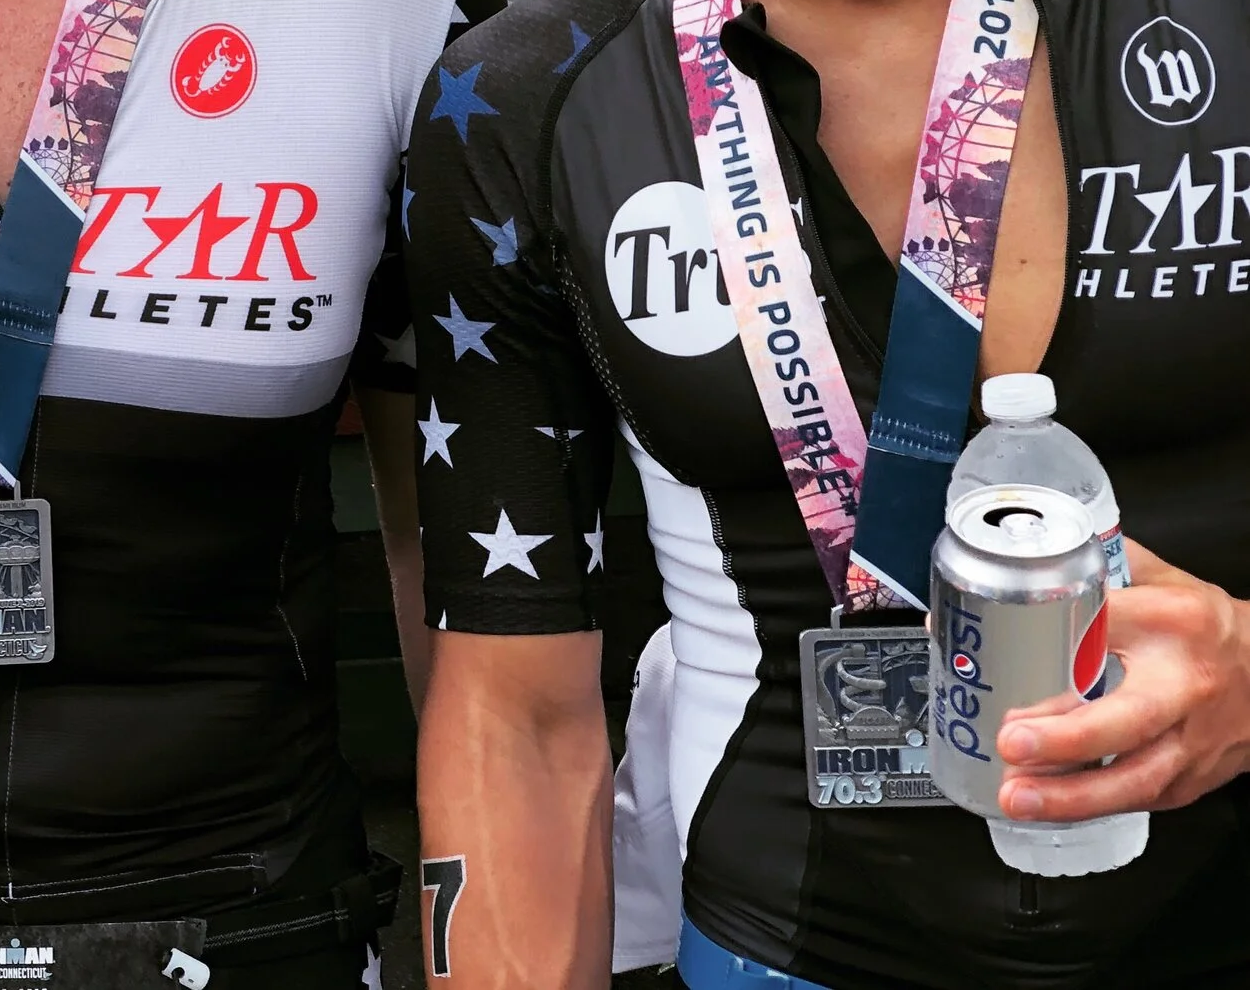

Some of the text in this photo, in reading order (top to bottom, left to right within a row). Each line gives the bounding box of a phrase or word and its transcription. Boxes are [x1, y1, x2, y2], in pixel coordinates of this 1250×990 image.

[697, 35, 768, 238] ANYTHING
[744, 250, 781, 289] IS
[1079, 146, 1250, 255] TAR
[1074, 259, 1250, 299] HLETE
[948, 600, 993, 762] pepsi
[814, 746, 931, 775] IRONM
[816, 774, 940, 805] 70.3 CONNEC
[422, 854, 468, 978] 7
